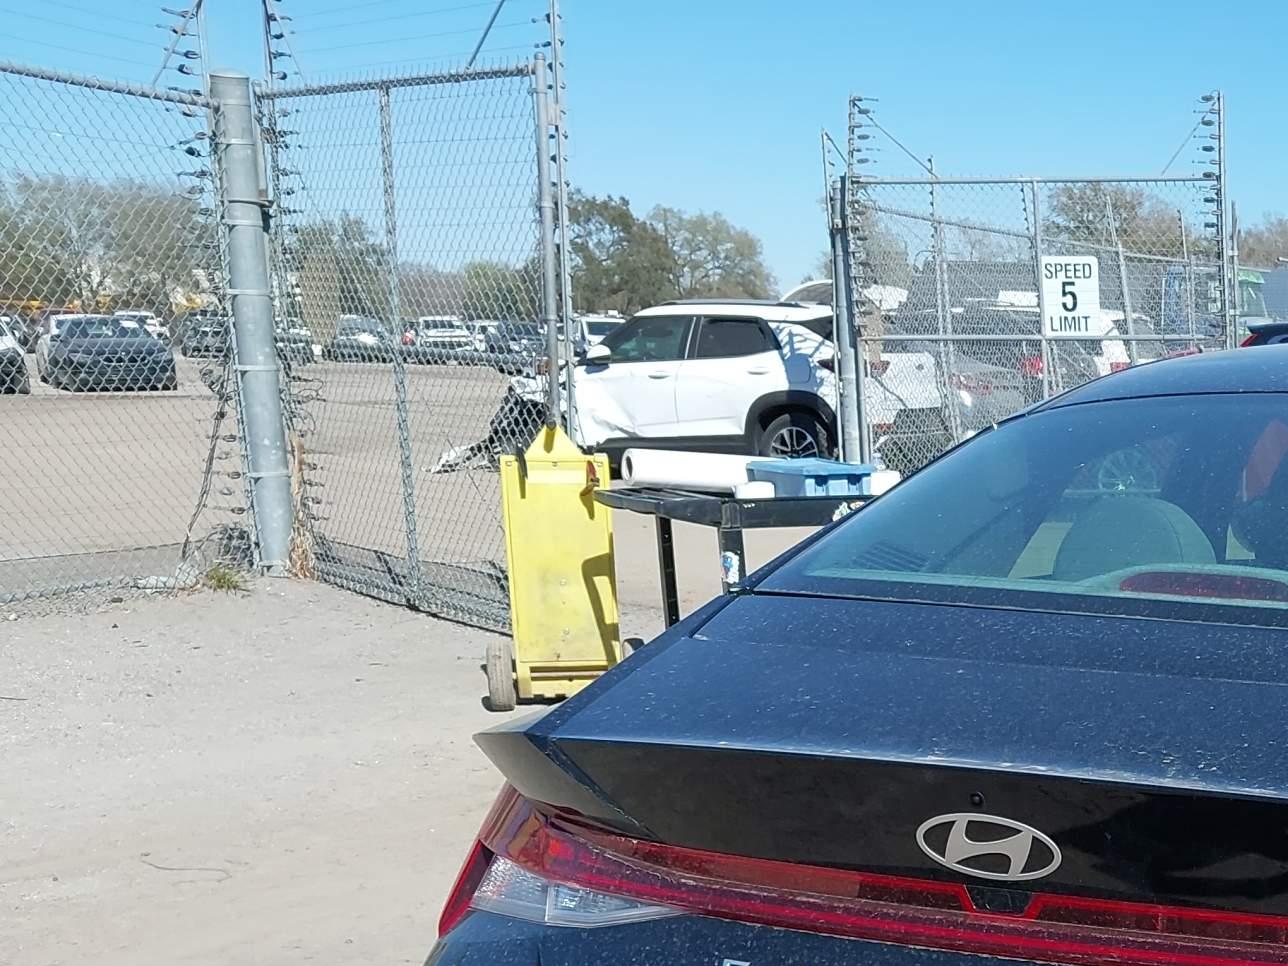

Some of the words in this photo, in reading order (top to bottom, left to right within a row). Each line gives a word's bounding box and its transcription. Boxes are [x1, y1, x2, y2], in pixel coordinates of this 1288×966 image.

[1044, 263, 1092, 279] SPEED
[1061, 281, 1078, 312] 5
[1050, 316, 1091, 332] LIMIT
